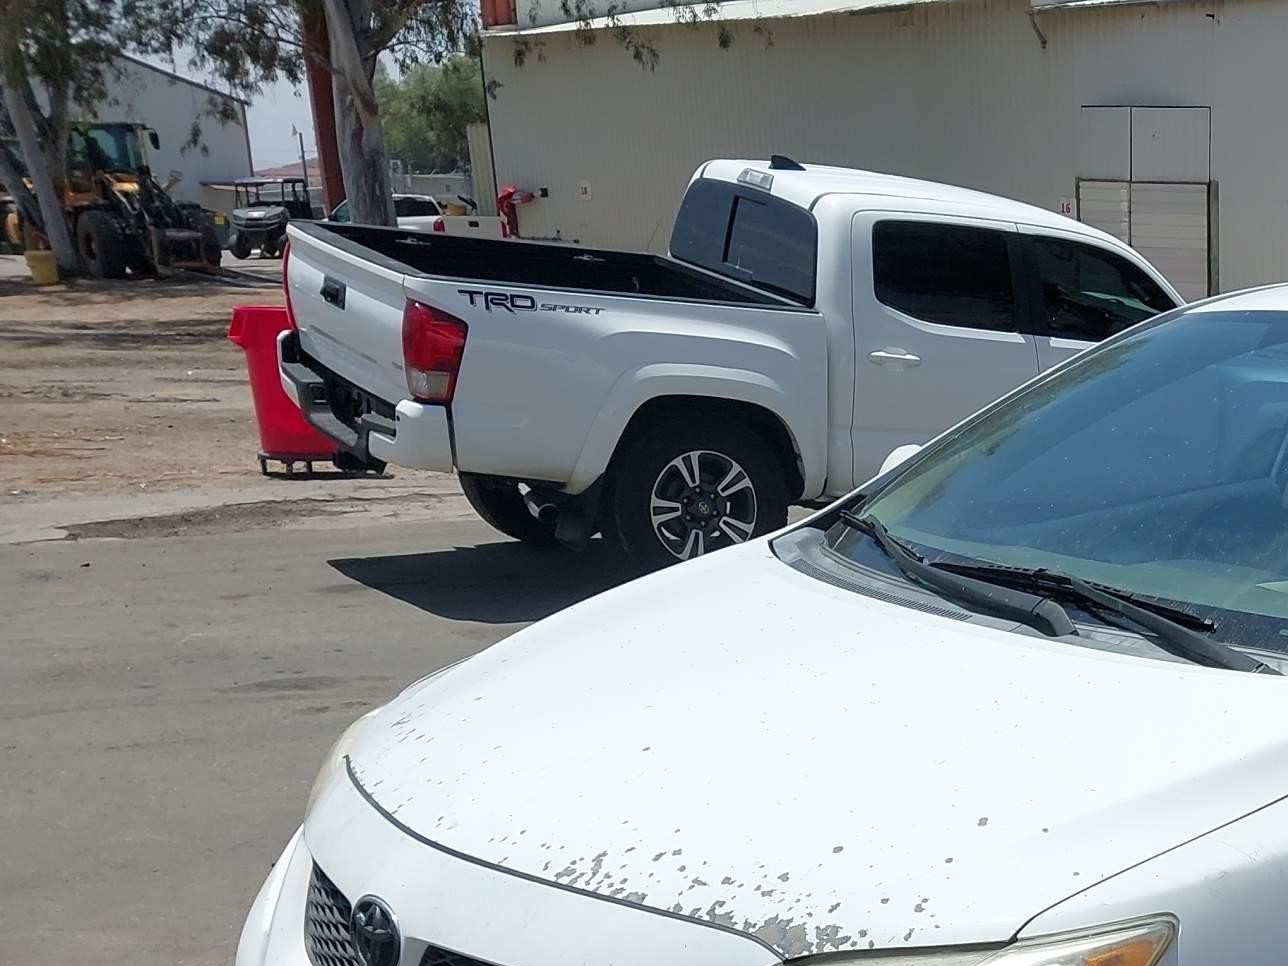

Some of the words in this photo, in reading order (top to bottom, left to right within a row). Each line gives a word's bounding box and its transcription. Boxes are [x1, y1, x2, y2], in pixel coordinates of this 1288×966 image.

[1061, 202, 1071, 214] 16
[457, 289, 537, 315] TRD
[540, 303, 605, 316] SPORT
